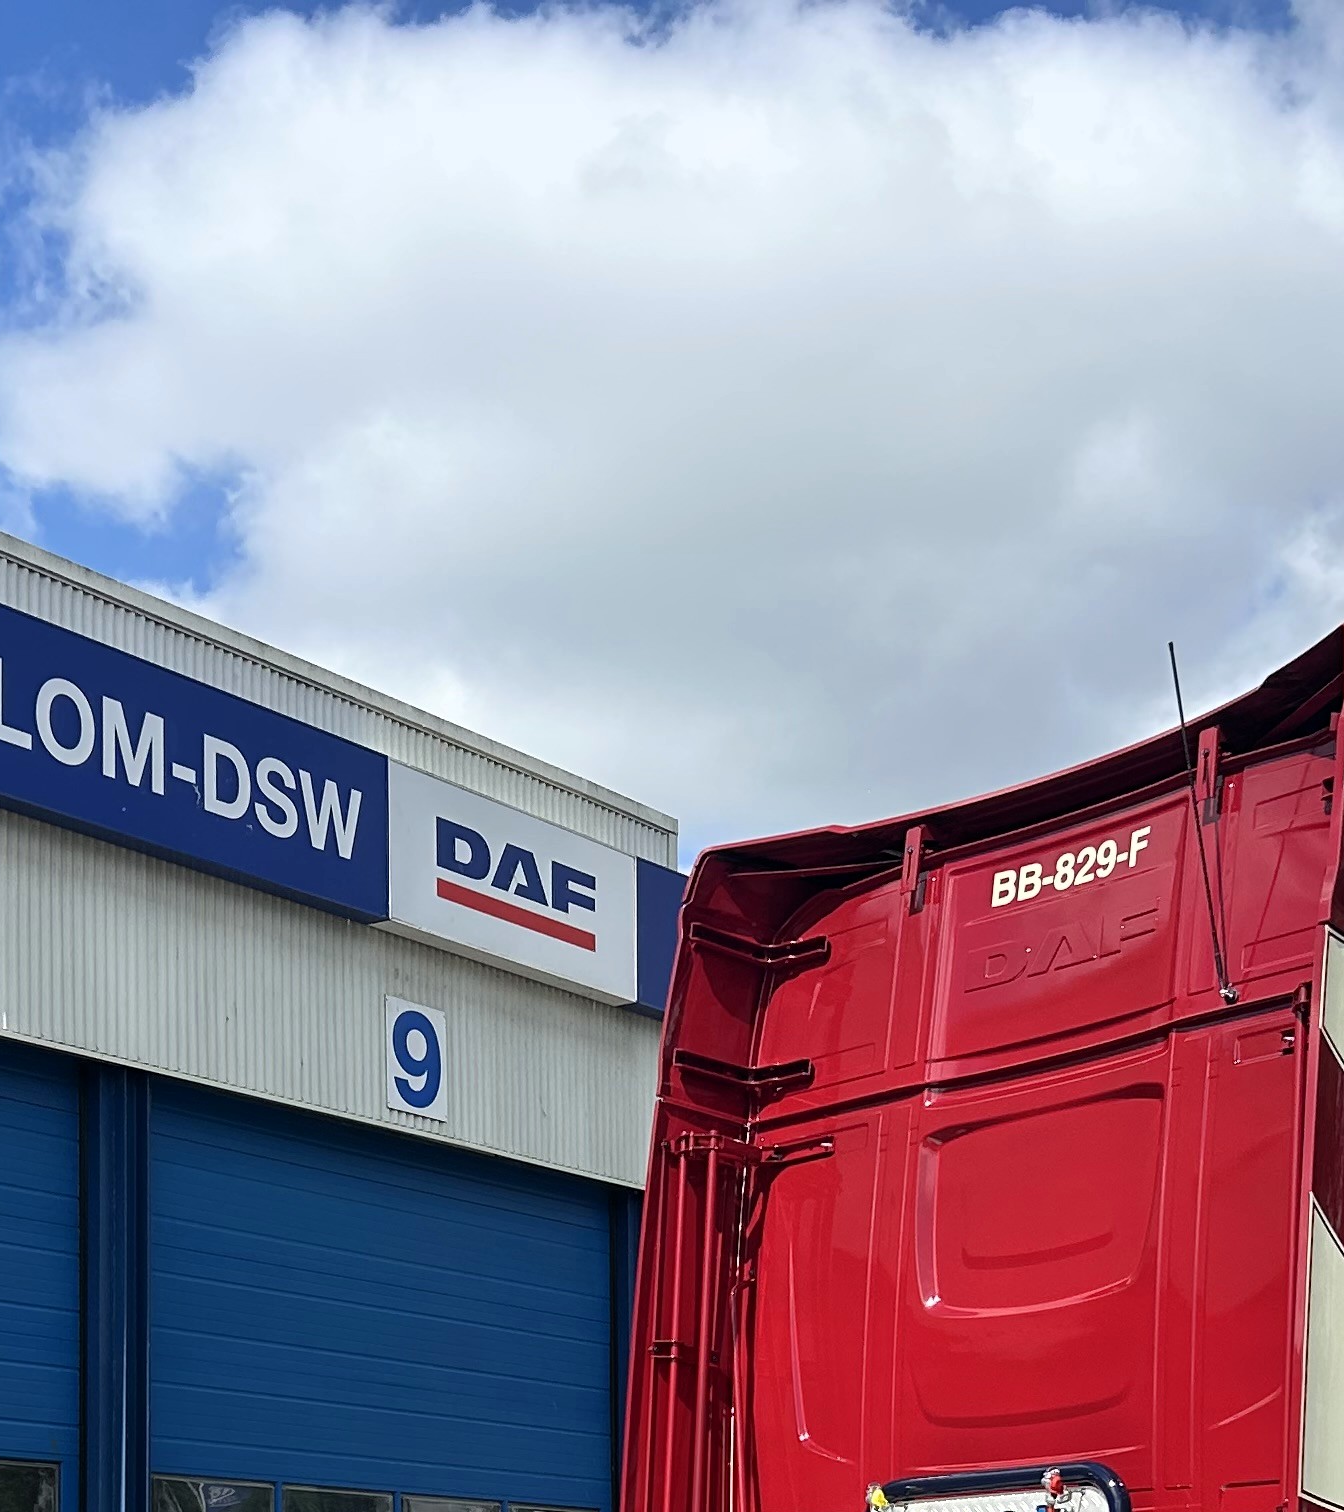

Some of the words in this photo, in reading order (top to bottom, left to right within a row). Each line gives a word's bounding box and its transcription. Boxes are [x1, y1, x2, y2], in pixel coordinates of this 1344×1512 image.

[435, 816, 597, 913] DAF
[991, 826, 1152, 908] BB-829-F
[963, 897, 1160, 993] DAF
[391, 1010, 443, 1109] 9
